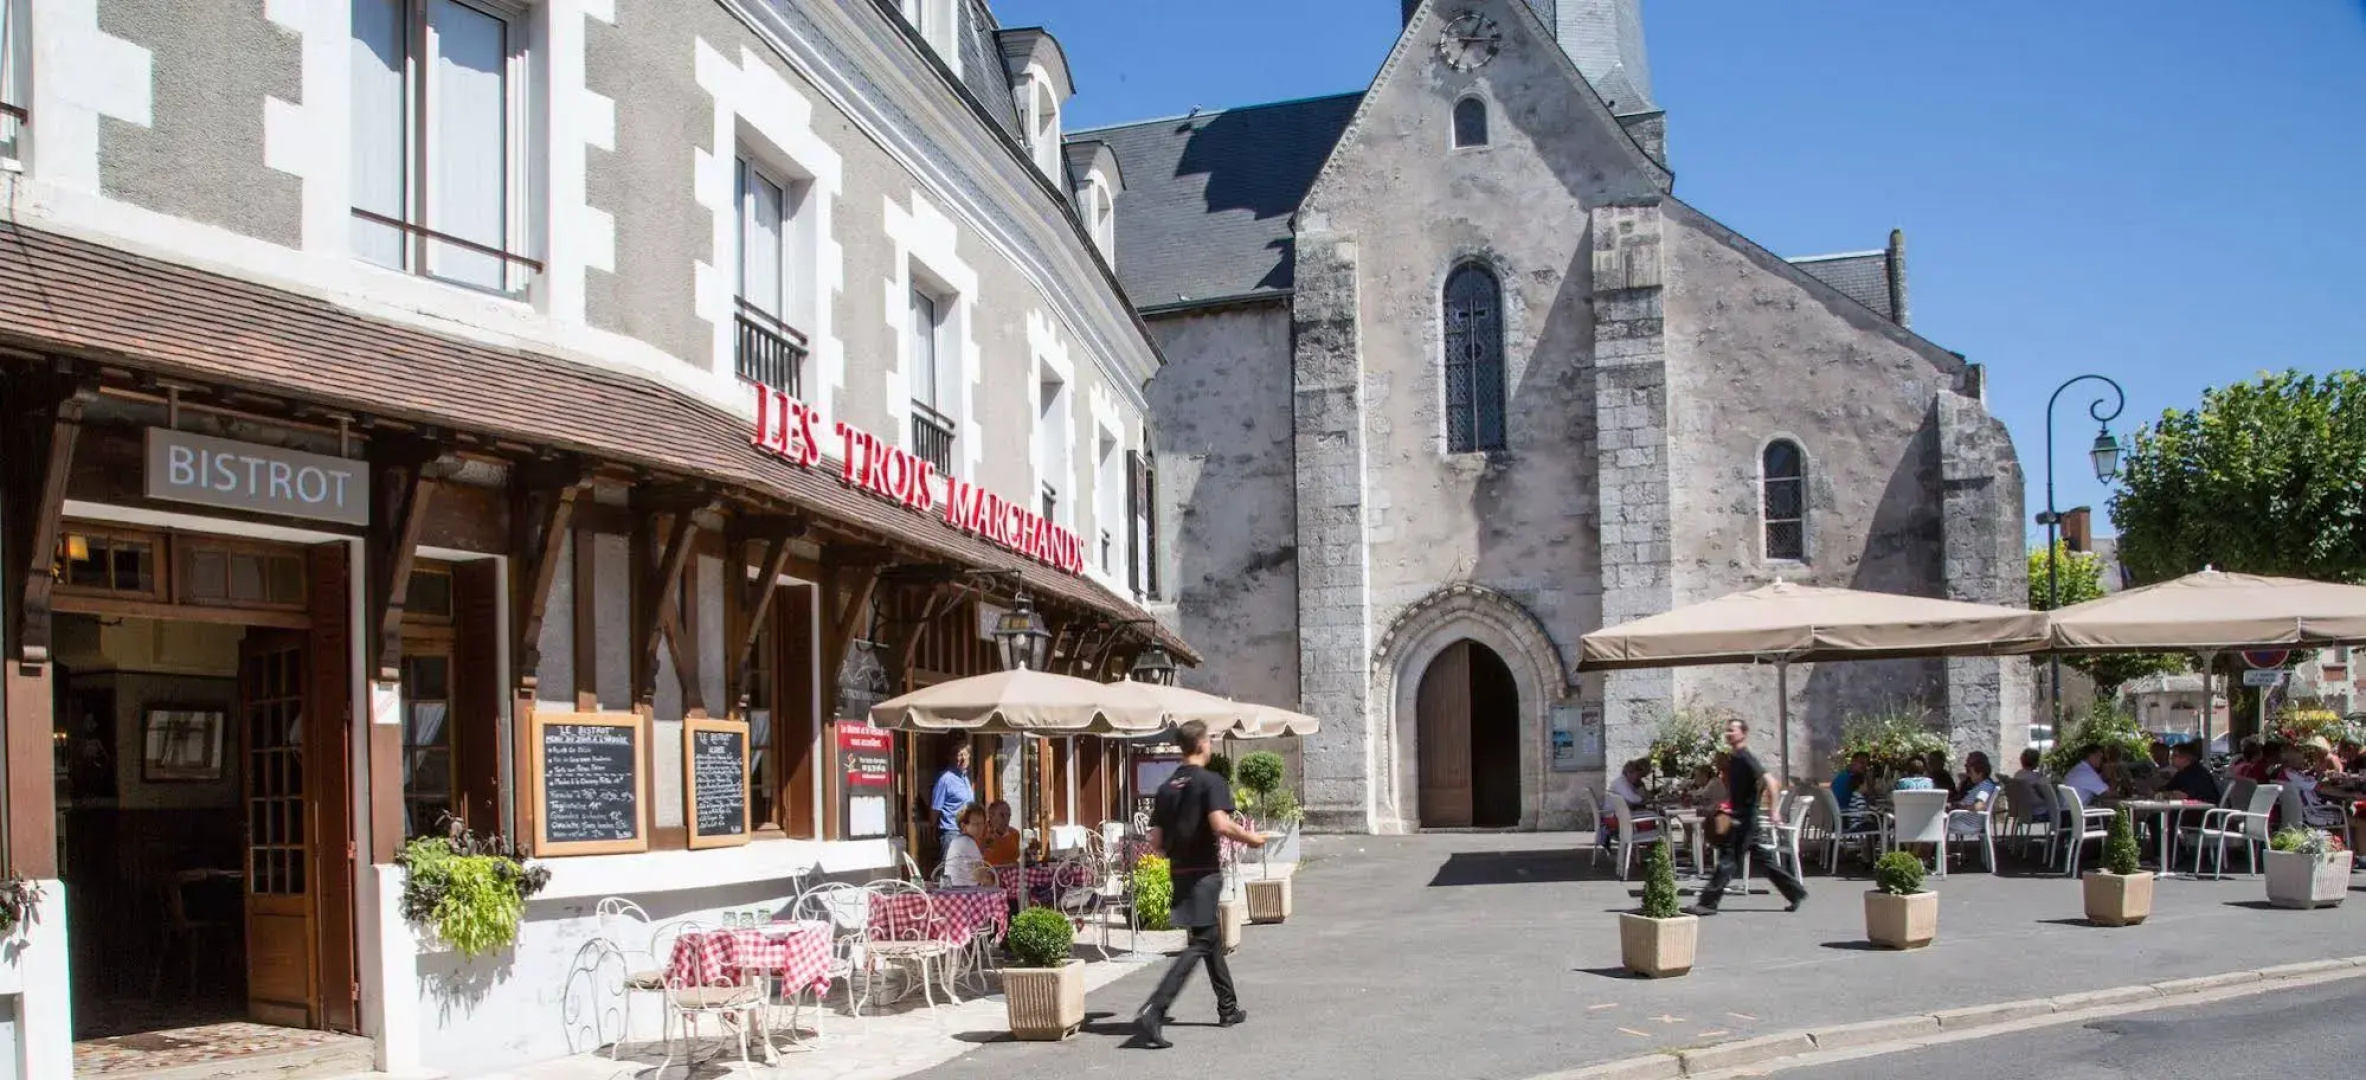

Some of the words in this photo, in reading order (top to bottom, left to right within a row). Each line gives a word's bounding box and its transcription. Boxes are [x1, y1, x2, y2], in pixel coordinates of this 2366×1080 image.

[168, 444, 352, 508] BISTROT
[751, 381, 822, 467] LES
[835, 421, 935, 512] TROIS
[943, 476, 1085, 575] MARCHANDS
